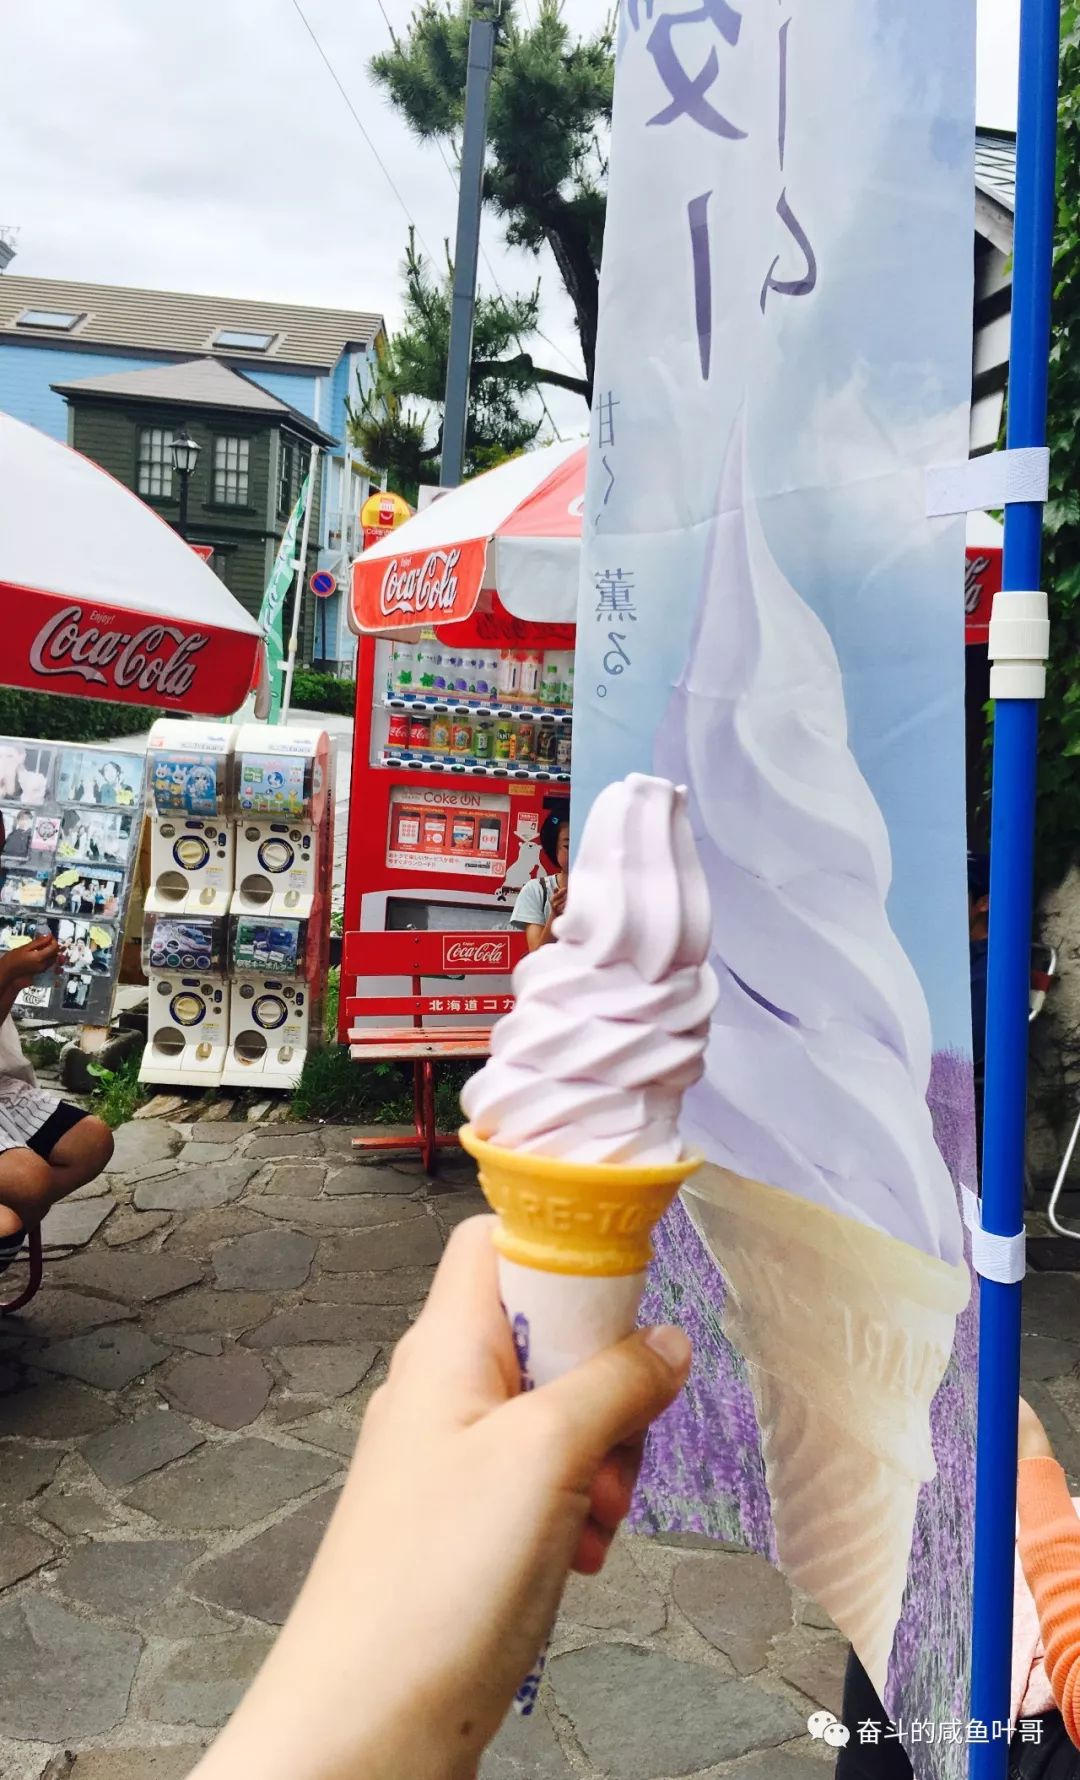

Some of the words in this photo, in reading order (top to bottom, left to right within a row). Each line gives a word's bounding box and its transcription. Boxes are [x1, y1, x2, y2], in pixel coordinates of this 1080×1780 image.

[380, 548, 462, 616] Coca-Cola
[90, 610, 116, 625] Enjoy!
[29, 606, 209, 696] Coca-Cola
[423, 791, 457, 805] Coke
[446, 942, 506, 962] Coca-Cola
